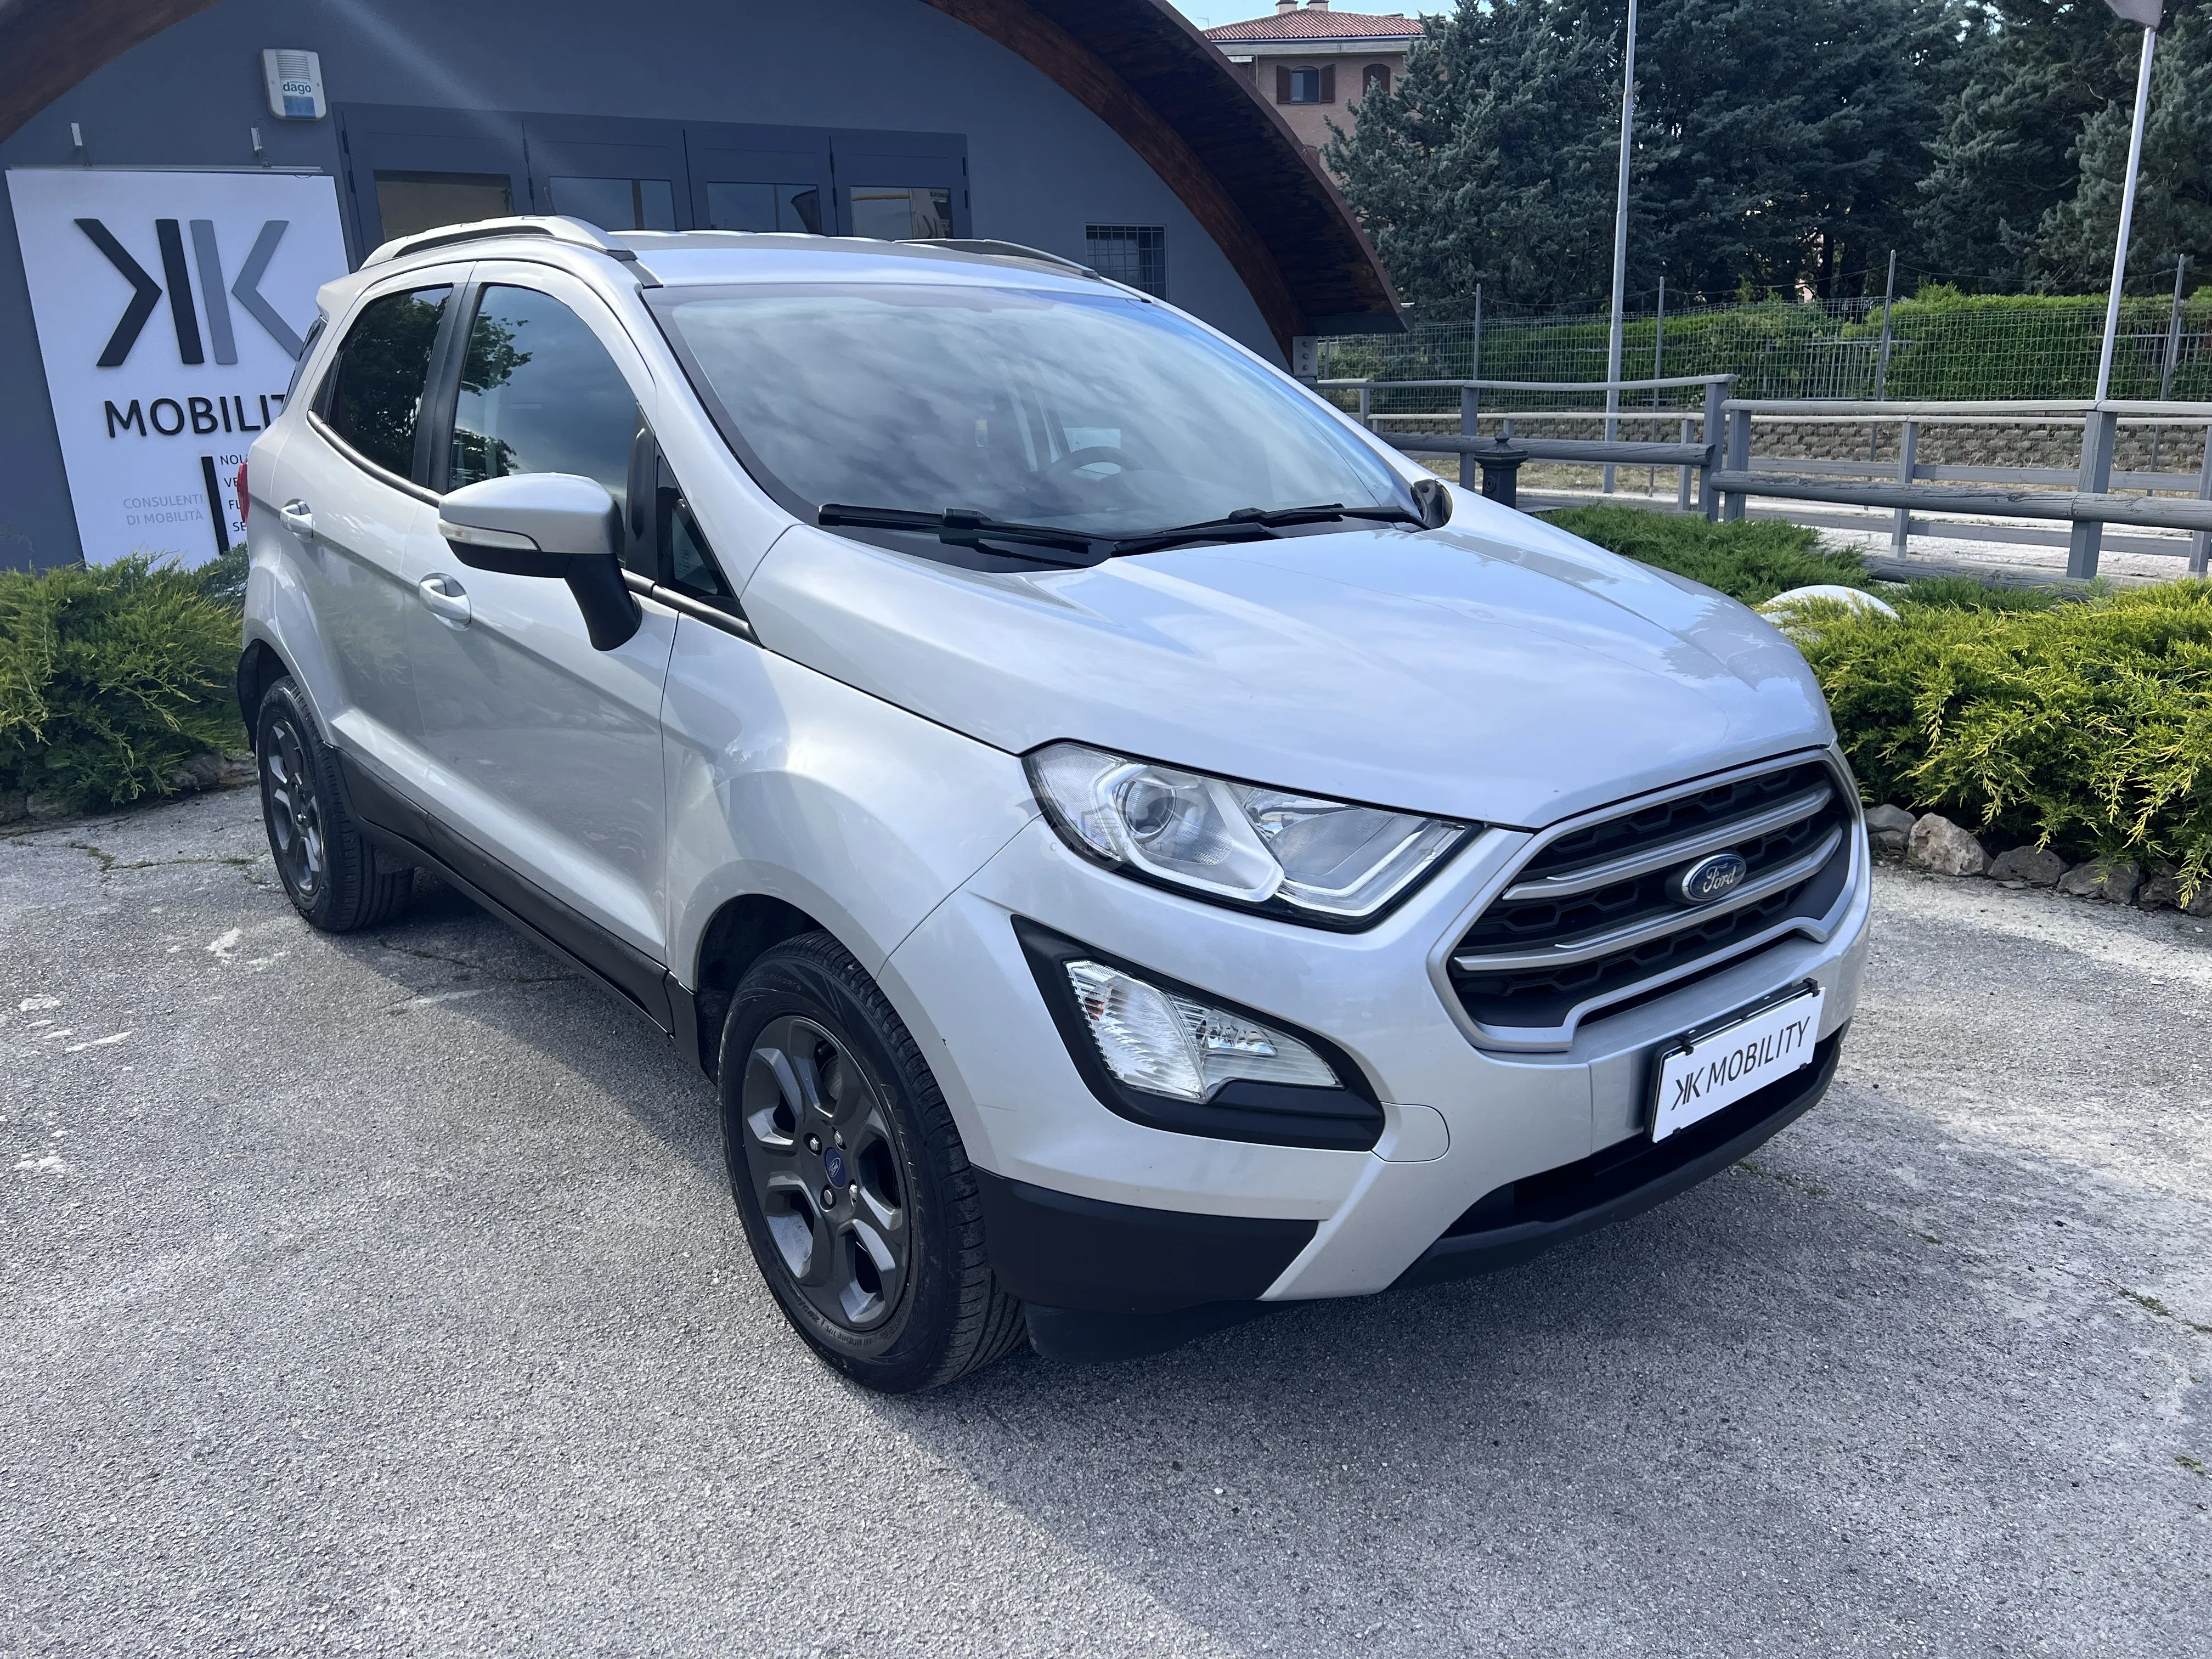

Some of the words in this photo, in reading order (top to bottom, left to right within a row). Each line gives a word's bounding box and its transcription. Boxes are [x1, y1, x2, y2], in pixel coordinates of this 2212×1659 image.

[283, 82, 311, 94] dago
[220, 454, 247, 465] NOL
[123, 494, 204, 509] CONSULENTI
[126, 515, 140, 525] DI
[144, 509, 204, 524] MOBILITÀ
[1703, 862, 1737, 893] Ford
[1706, 1016, 1810, 1093] MOBILITY
